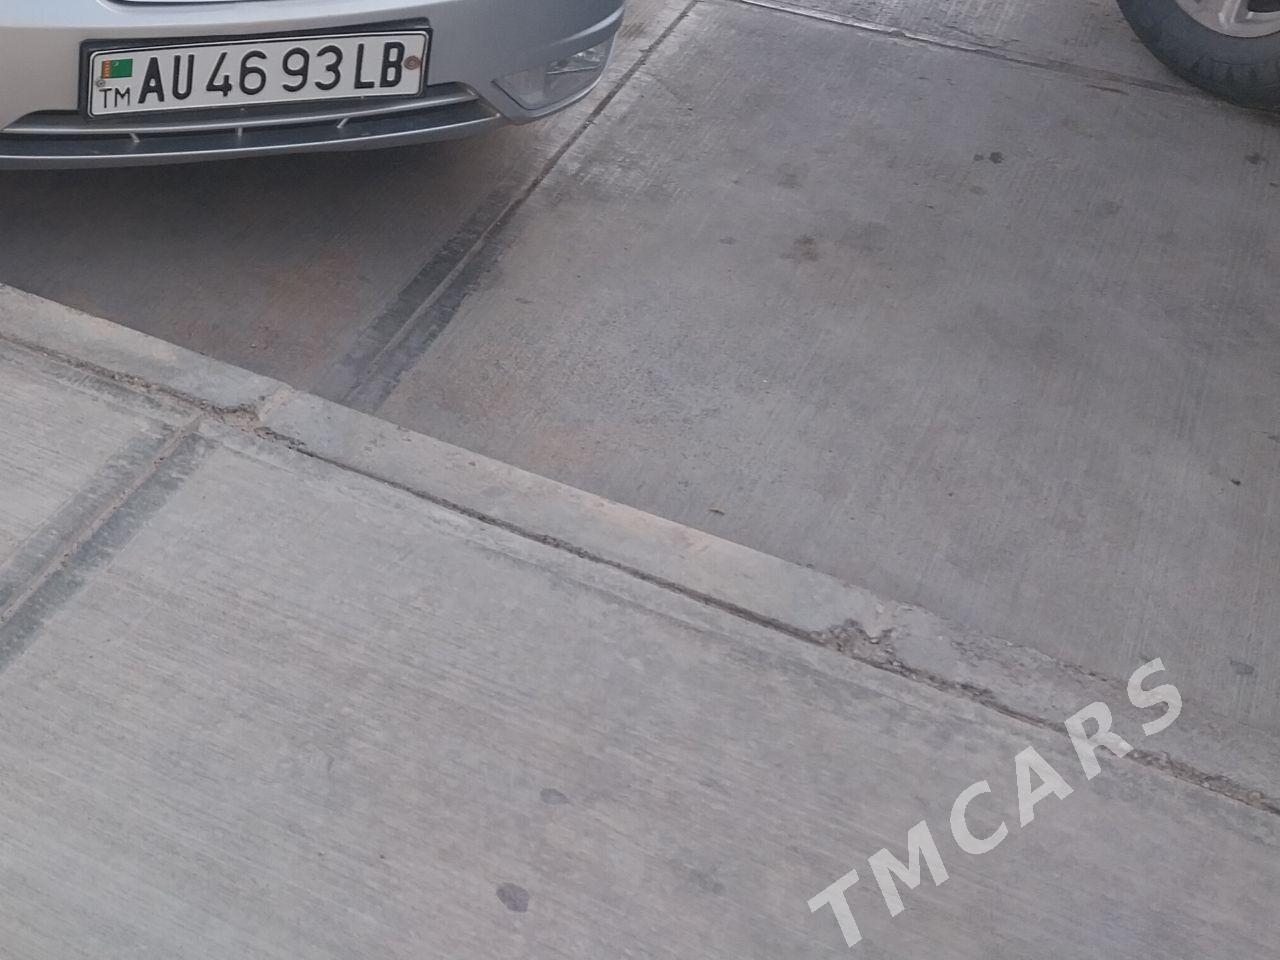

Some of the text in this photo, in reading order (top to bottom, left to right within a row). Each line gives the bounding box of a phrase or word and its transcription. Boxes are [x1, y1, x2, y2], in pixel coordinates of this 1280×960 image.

[137, 41, 406, 104] AU 46 93 LB
[98, 87, 132, 109] TM
